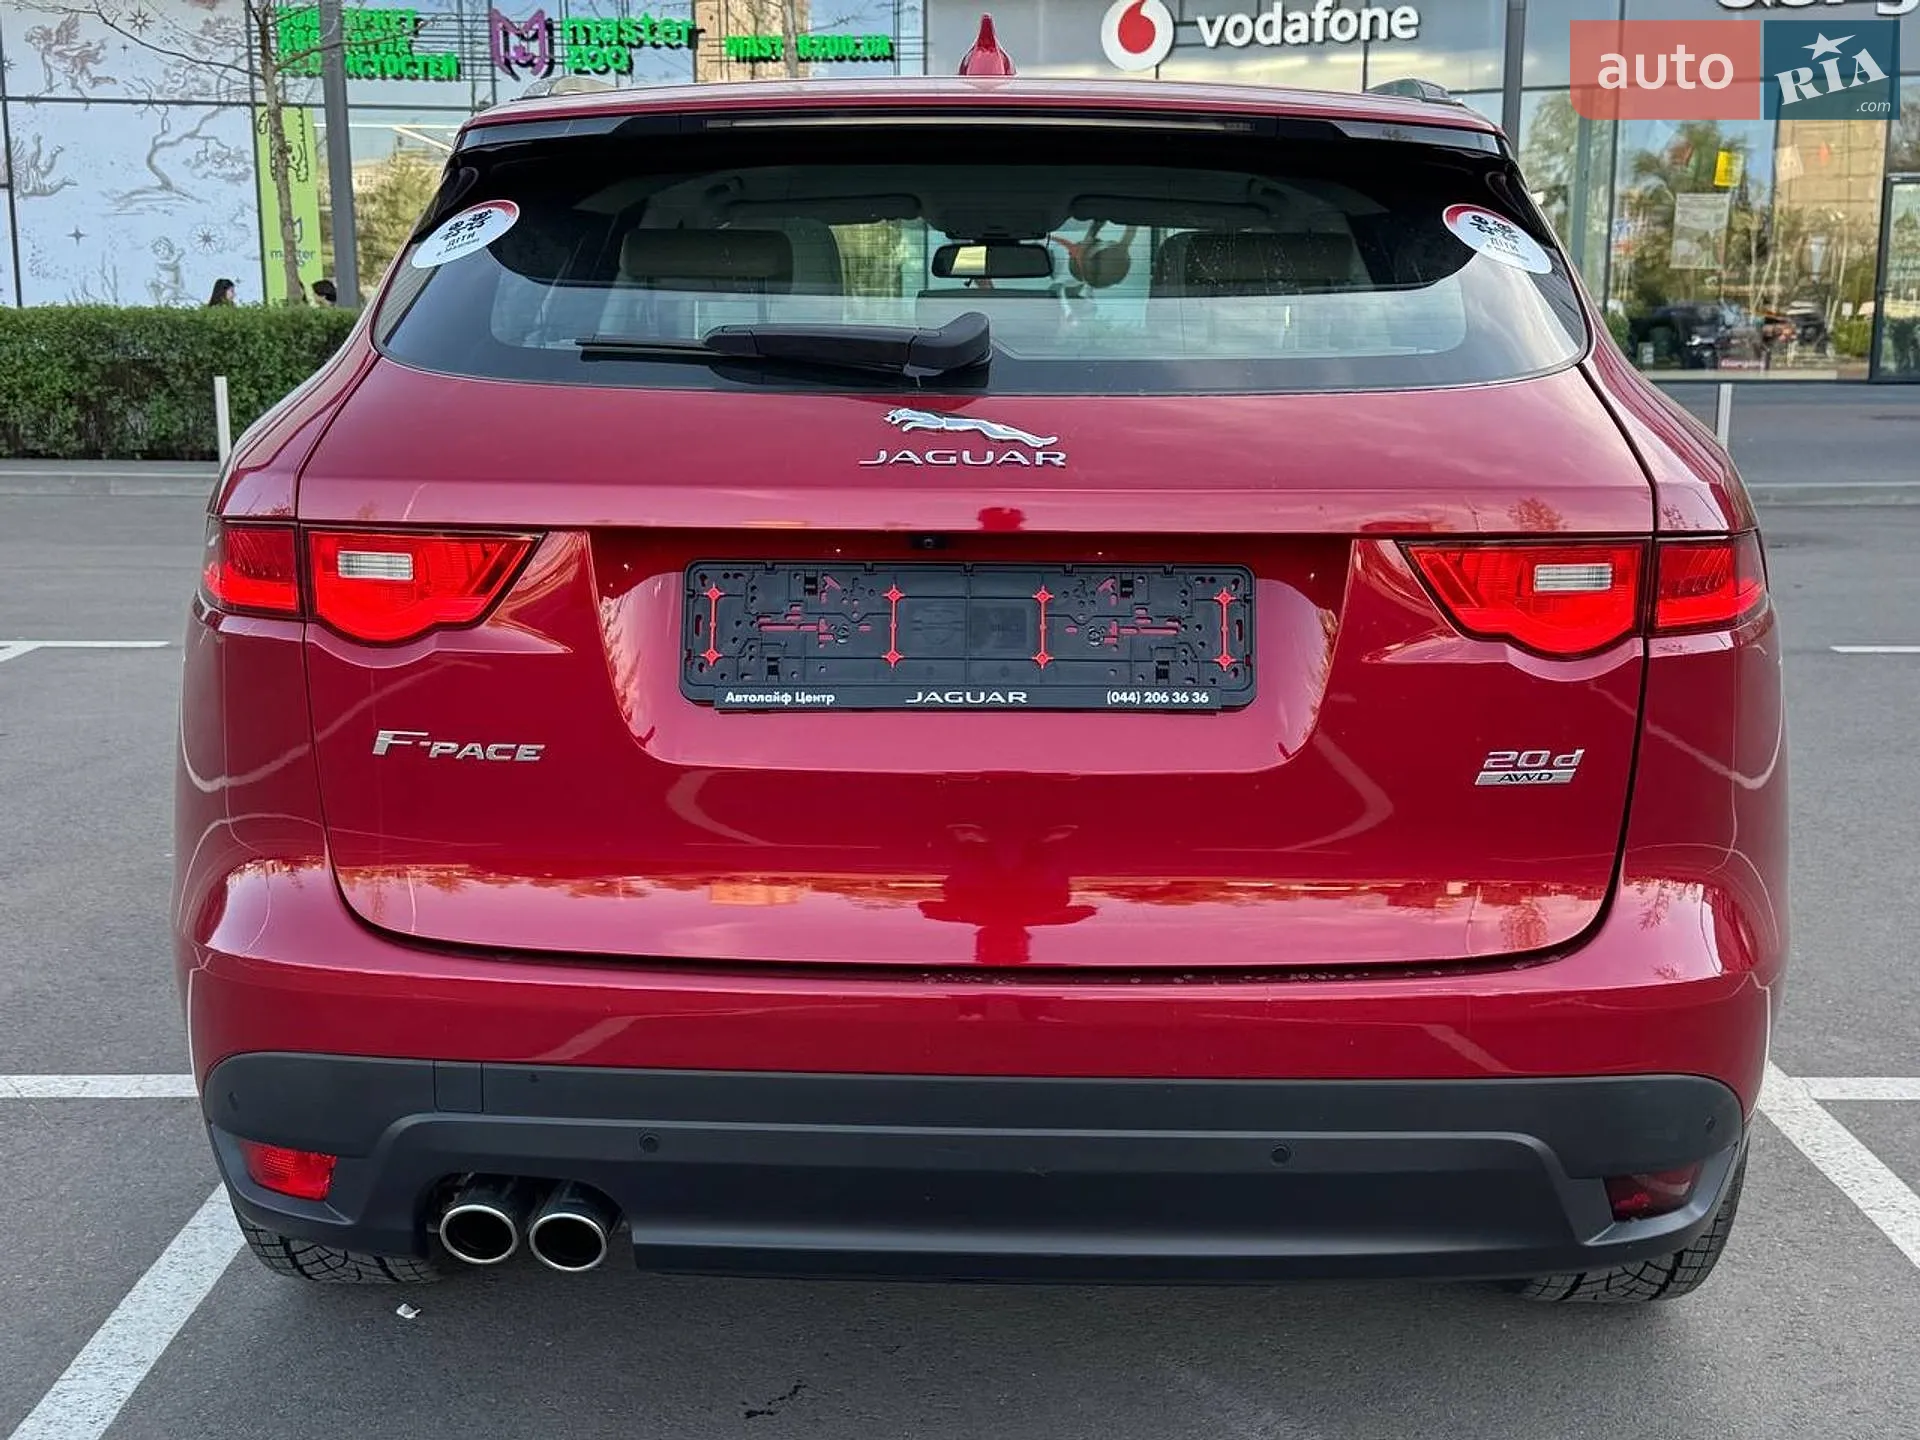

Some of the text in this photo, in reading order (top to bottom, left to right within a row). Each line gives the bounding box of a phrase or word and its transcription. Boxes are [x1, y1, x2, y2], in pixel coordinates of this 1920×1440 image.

[562, 12, 695, 47] master
[1197, 0, 1420, 48] vodafone
[724, 33, 892, 58] MASTRZOO.UA
[859, 449, 1067, 468] JAGUAR
[724, 691, 836, 706] Автолайф Центр
[905, 691, 1028, 704] JAGUAR
[1106, 690, 1209, 705] (044) 206 36 36
[372, 729, 545, 762] F-PACE
[1483, 748, 1586, 770] 20d
[1498, 772, 1553, 783] AWD
